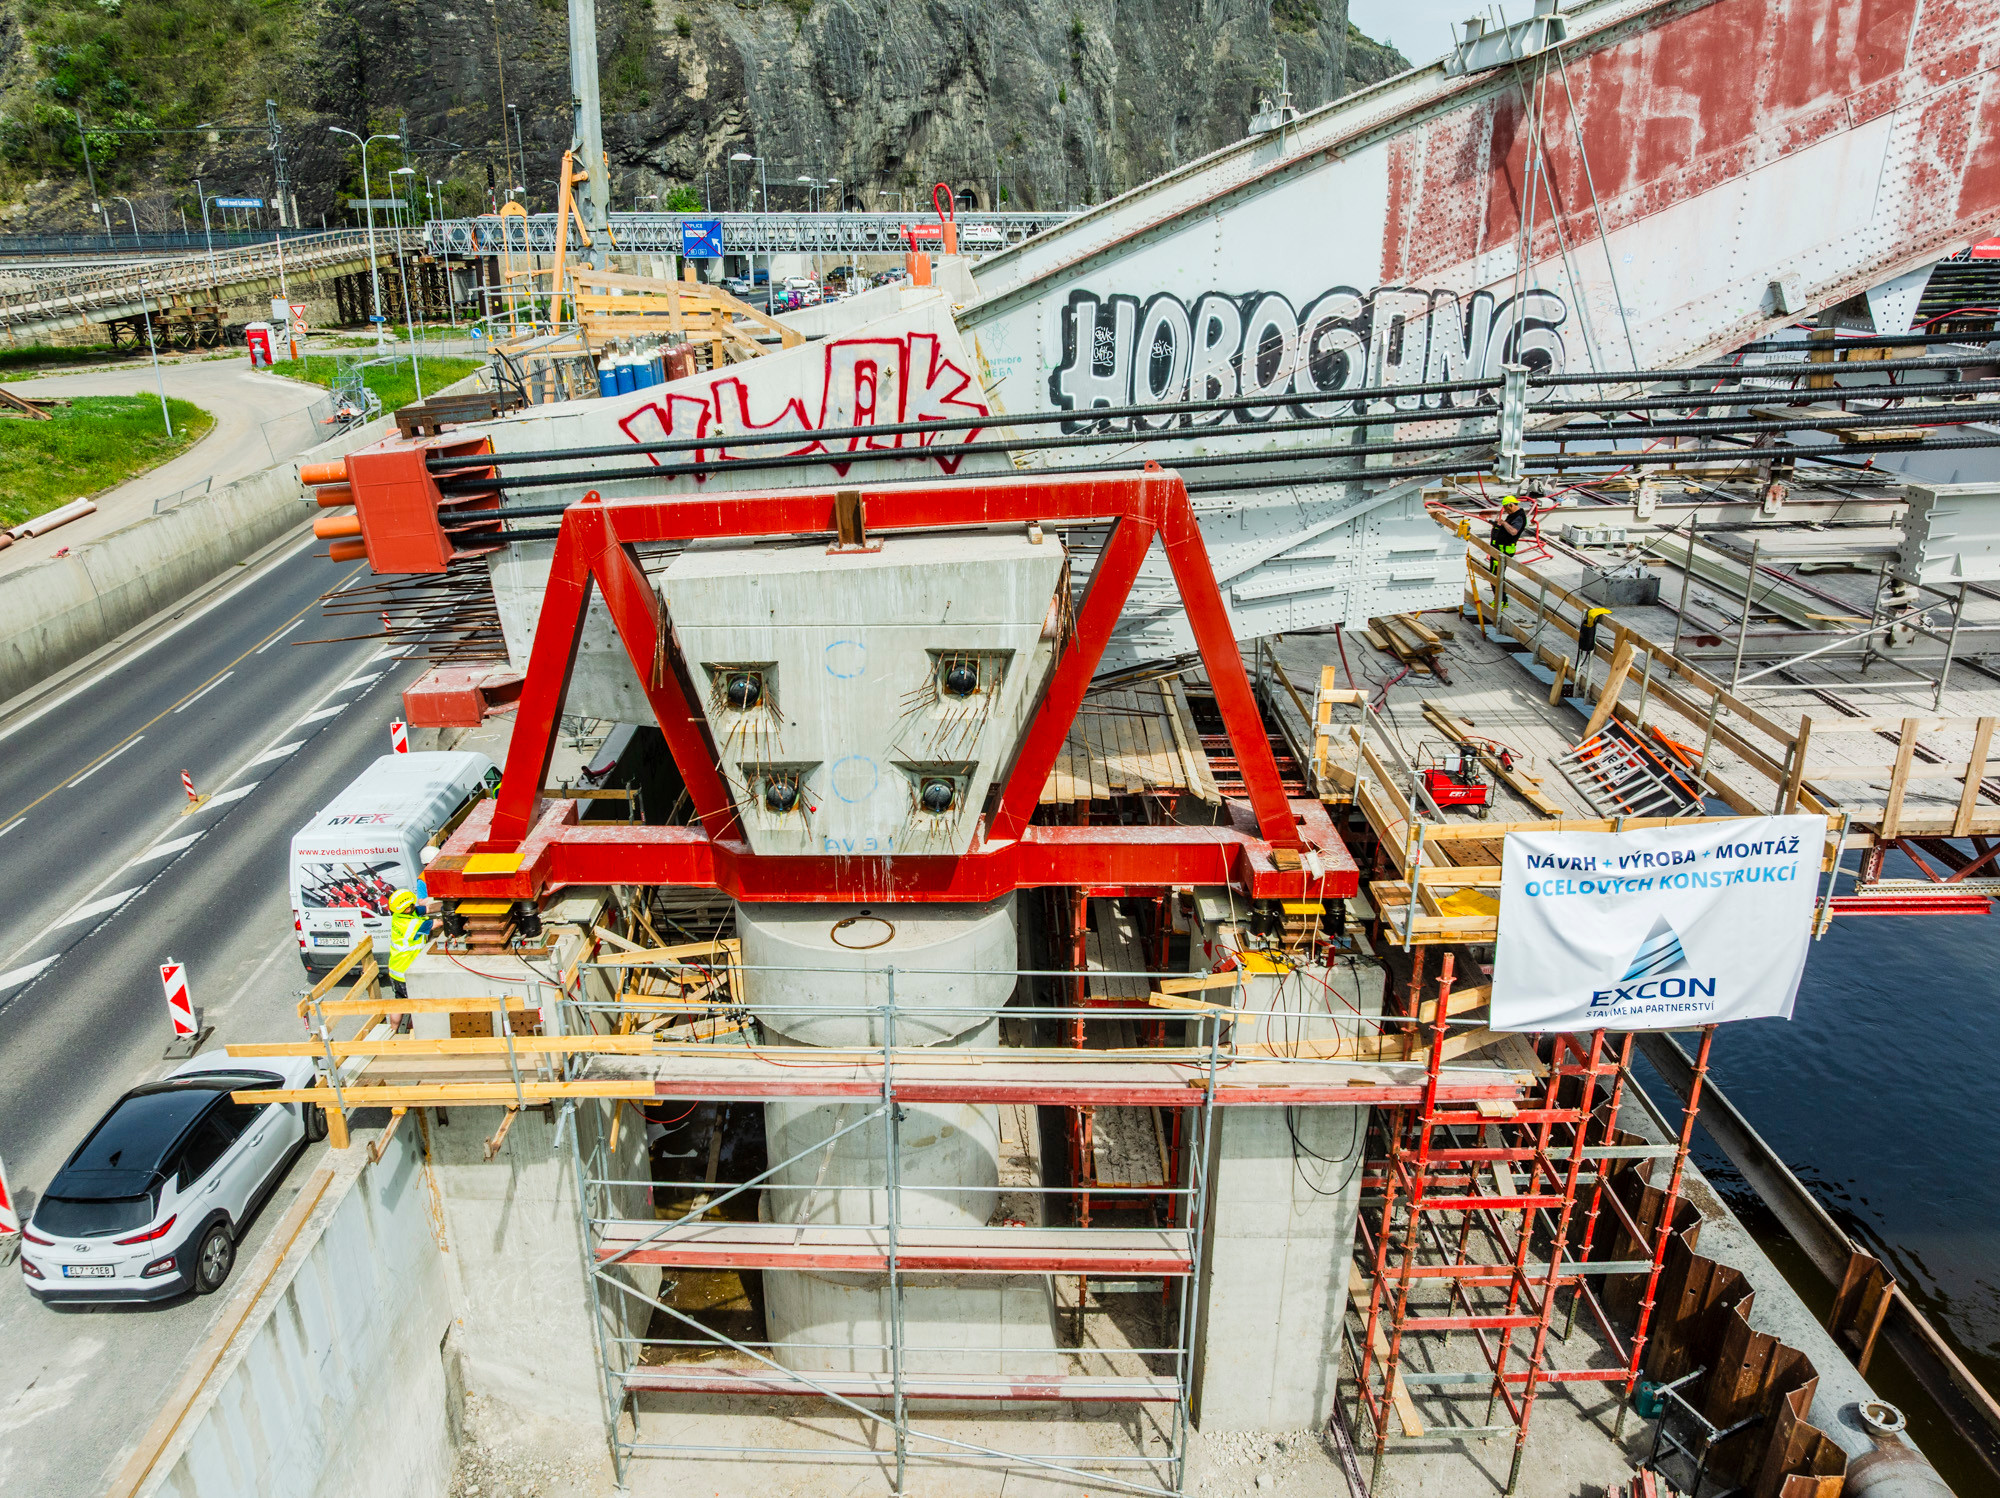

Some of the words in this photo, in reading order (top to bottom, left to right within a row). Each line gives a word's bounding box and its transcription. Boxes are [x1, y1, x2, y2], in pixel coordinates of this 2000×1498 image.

[298, 846, 399, 856] www.zvedanimostu.eu
[1526, 853, 1597, 871] NÁVRH
[1602, 859, 1612, 869] +
[1618, 849, 1696, 870] VÝROBA
[1702, 849, 1711, 858] +
[1715, 836, 1800, 859] MONTÁŽ
[1525, 876, 1653, 897] OCELOVÝCH
[1659, 861, 1798, 890] KONSTRUKCÍ
[304, 911, 311, 920] 2
[335, 919, 355, 928] MTEK
[1590, 978, 1717, 1008] EXCON
[1585, 1007, 1628, 1018] STAVÍME
[1630, 1006, 1643, 1015] NA
[1645, 1000, 1715, 1013] PARTNERSTVÍ
[69, 1266, 84, 1275] EL7
